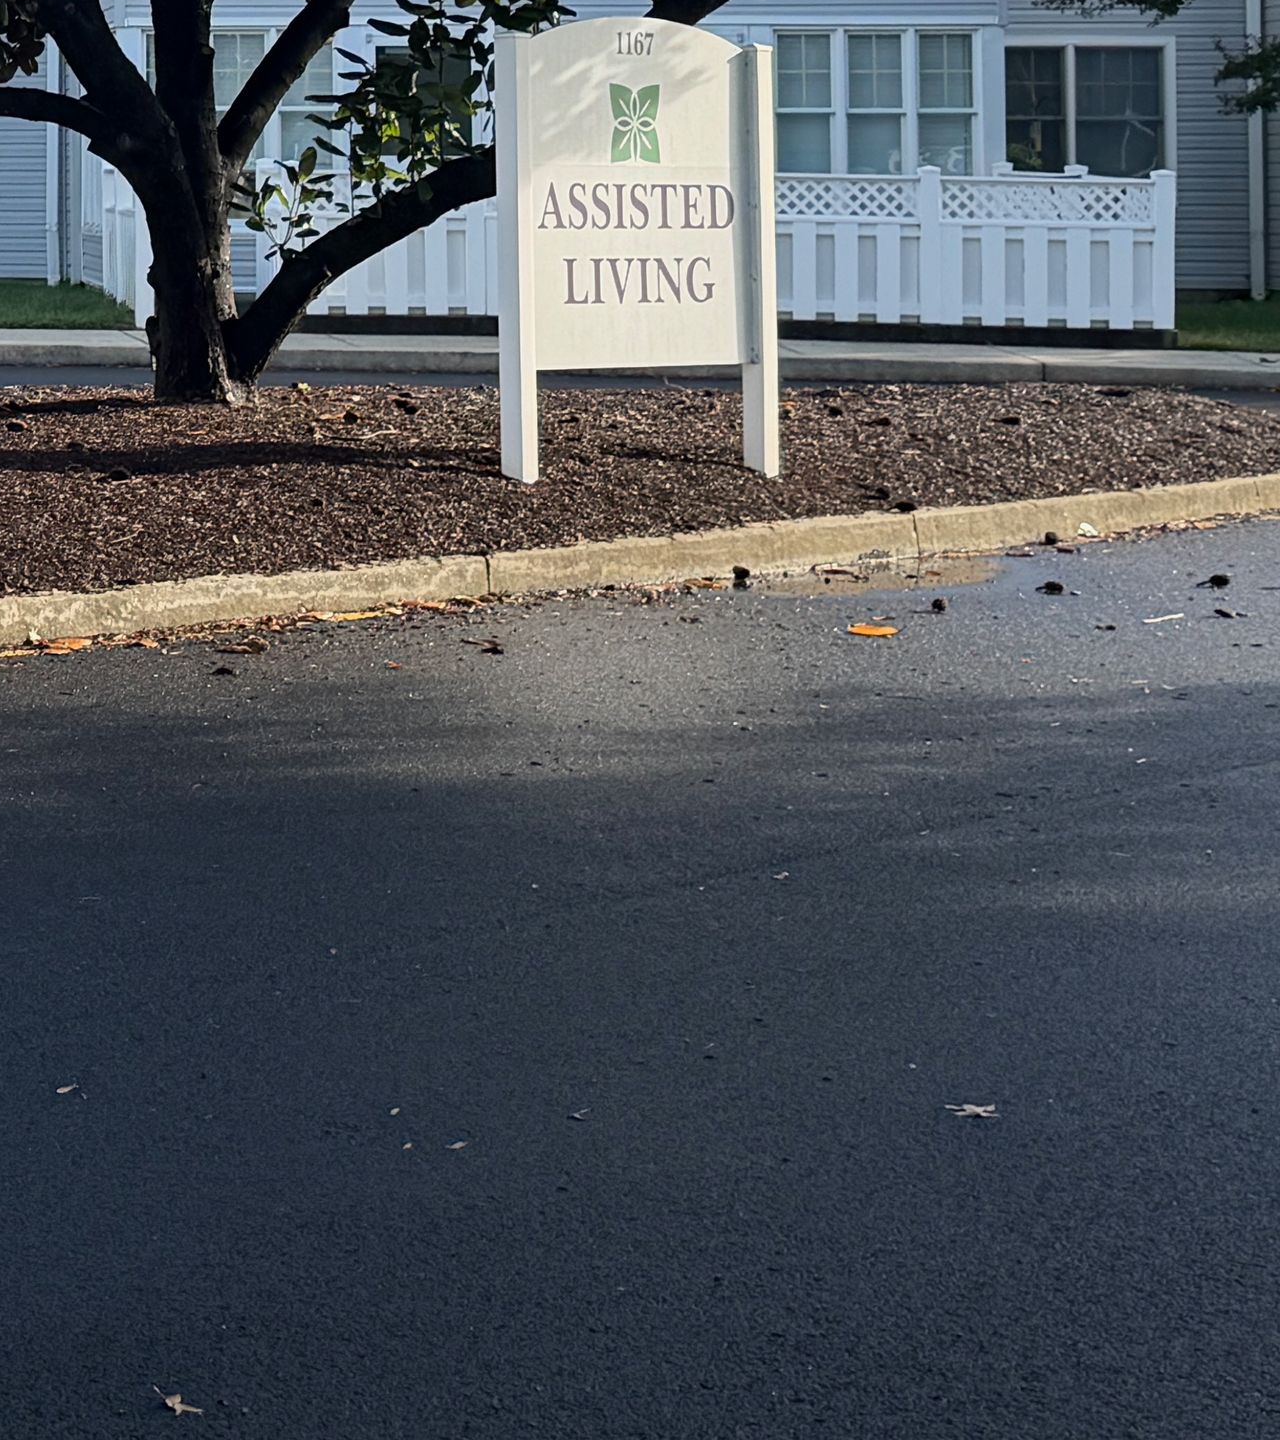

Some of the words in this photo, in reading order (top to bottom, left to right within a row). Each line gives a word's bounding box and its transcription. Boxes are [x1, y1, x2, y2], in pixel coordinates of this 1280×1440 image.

[616, 31, 654, 56] 1167
[537, 181, 735, 230] ASSISTED
[562, 256, 716, 305] LIVING
